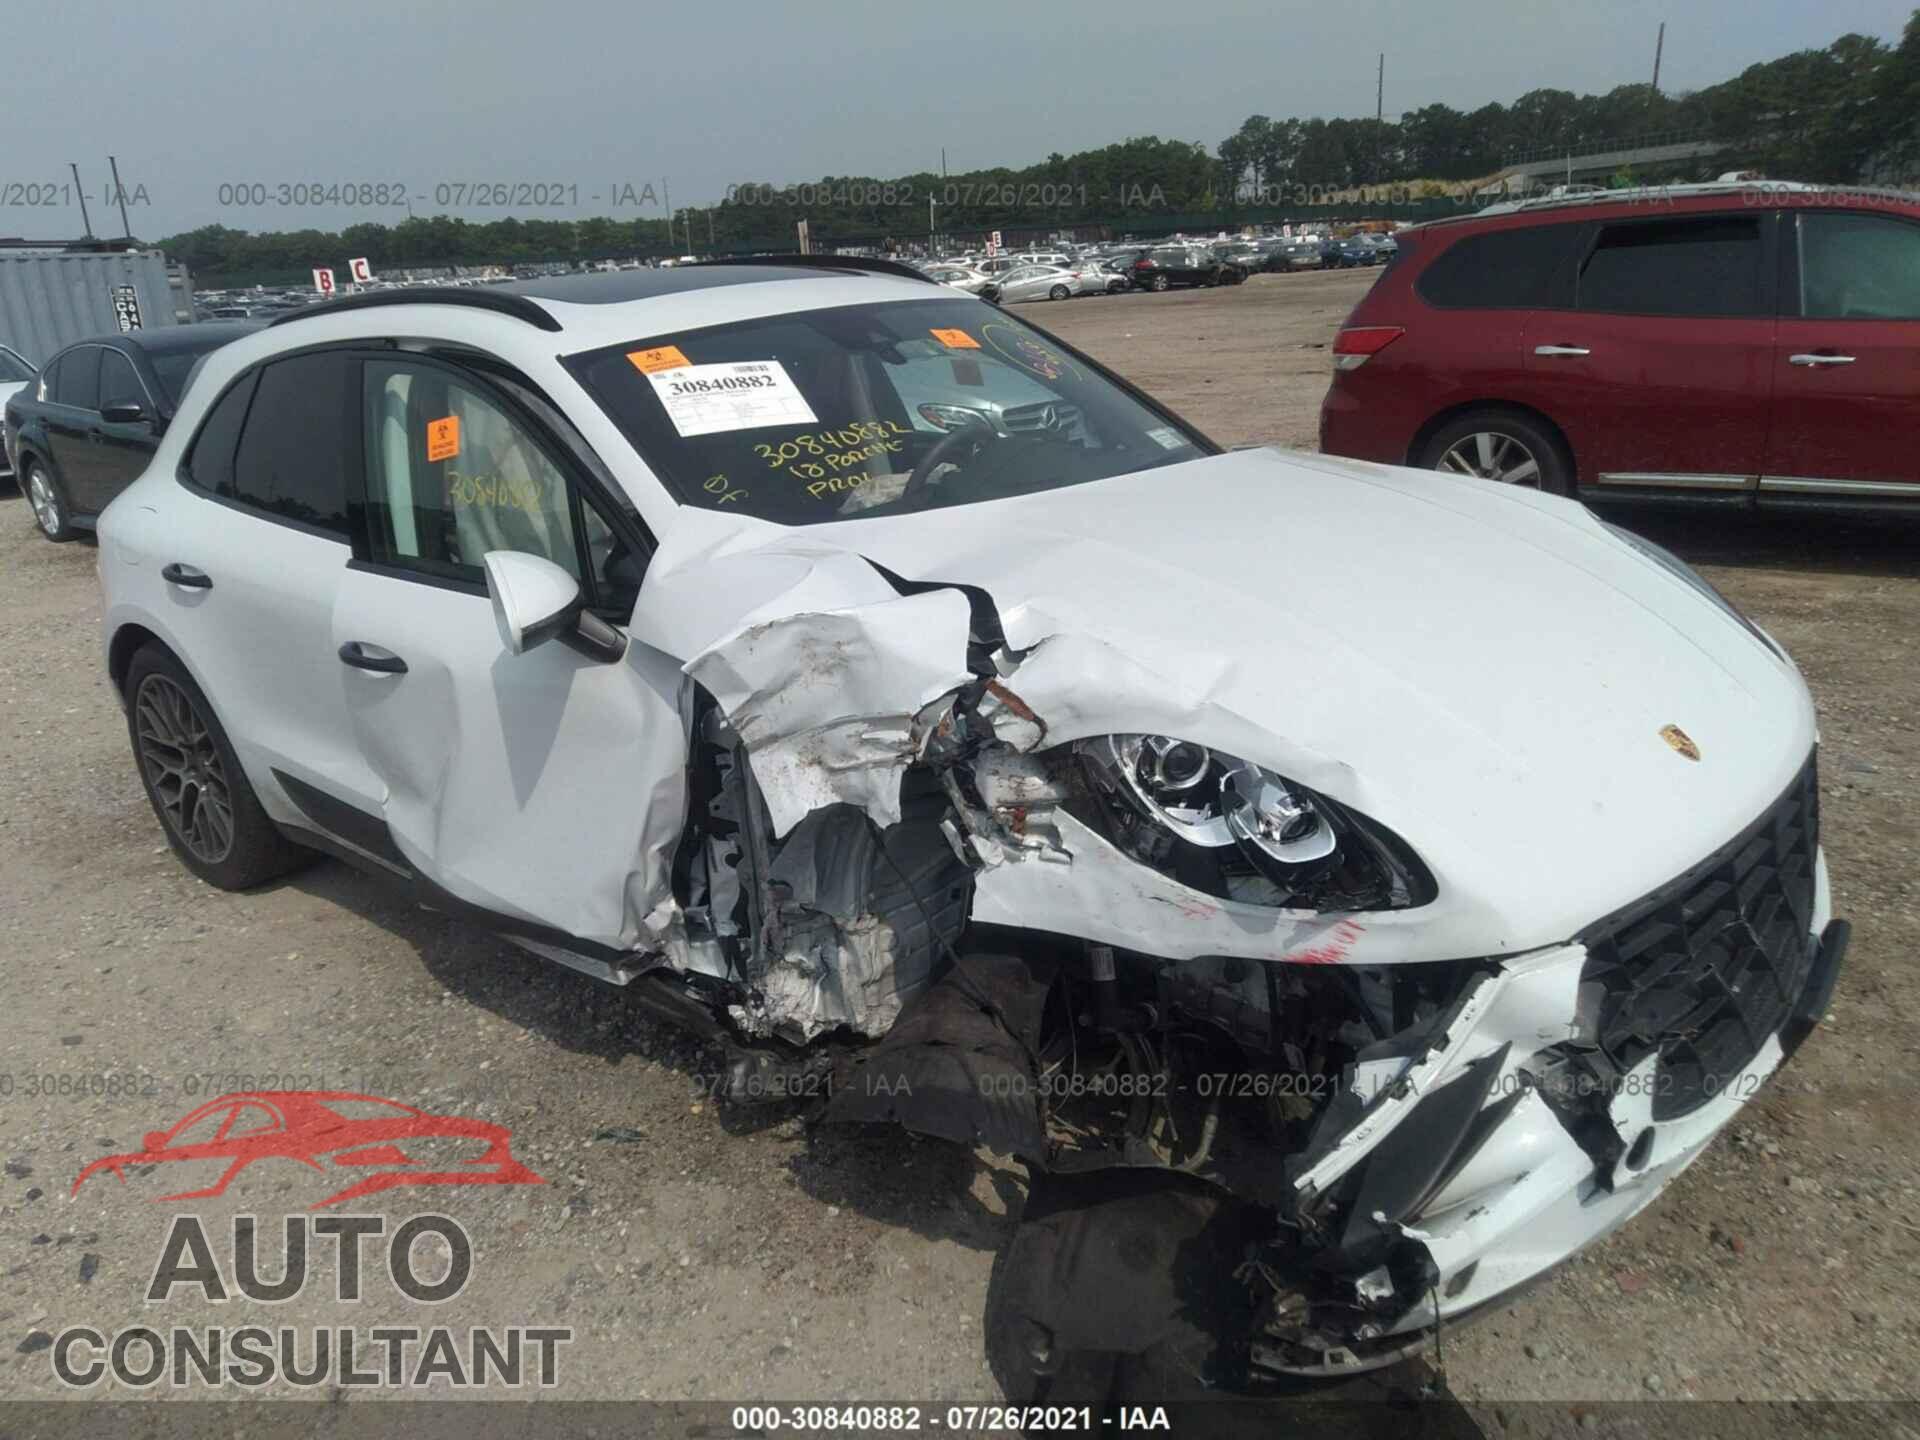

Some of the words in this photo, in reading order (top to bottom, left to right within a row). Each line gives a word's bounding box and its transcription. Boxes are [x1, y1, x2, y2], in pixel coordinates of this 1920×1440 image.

[319, 271, 332, 290] B
[354, 260, 368, 281] C
[669, 374, 777, 396] 30840882
[754, 420, 914, 467] 30840882
